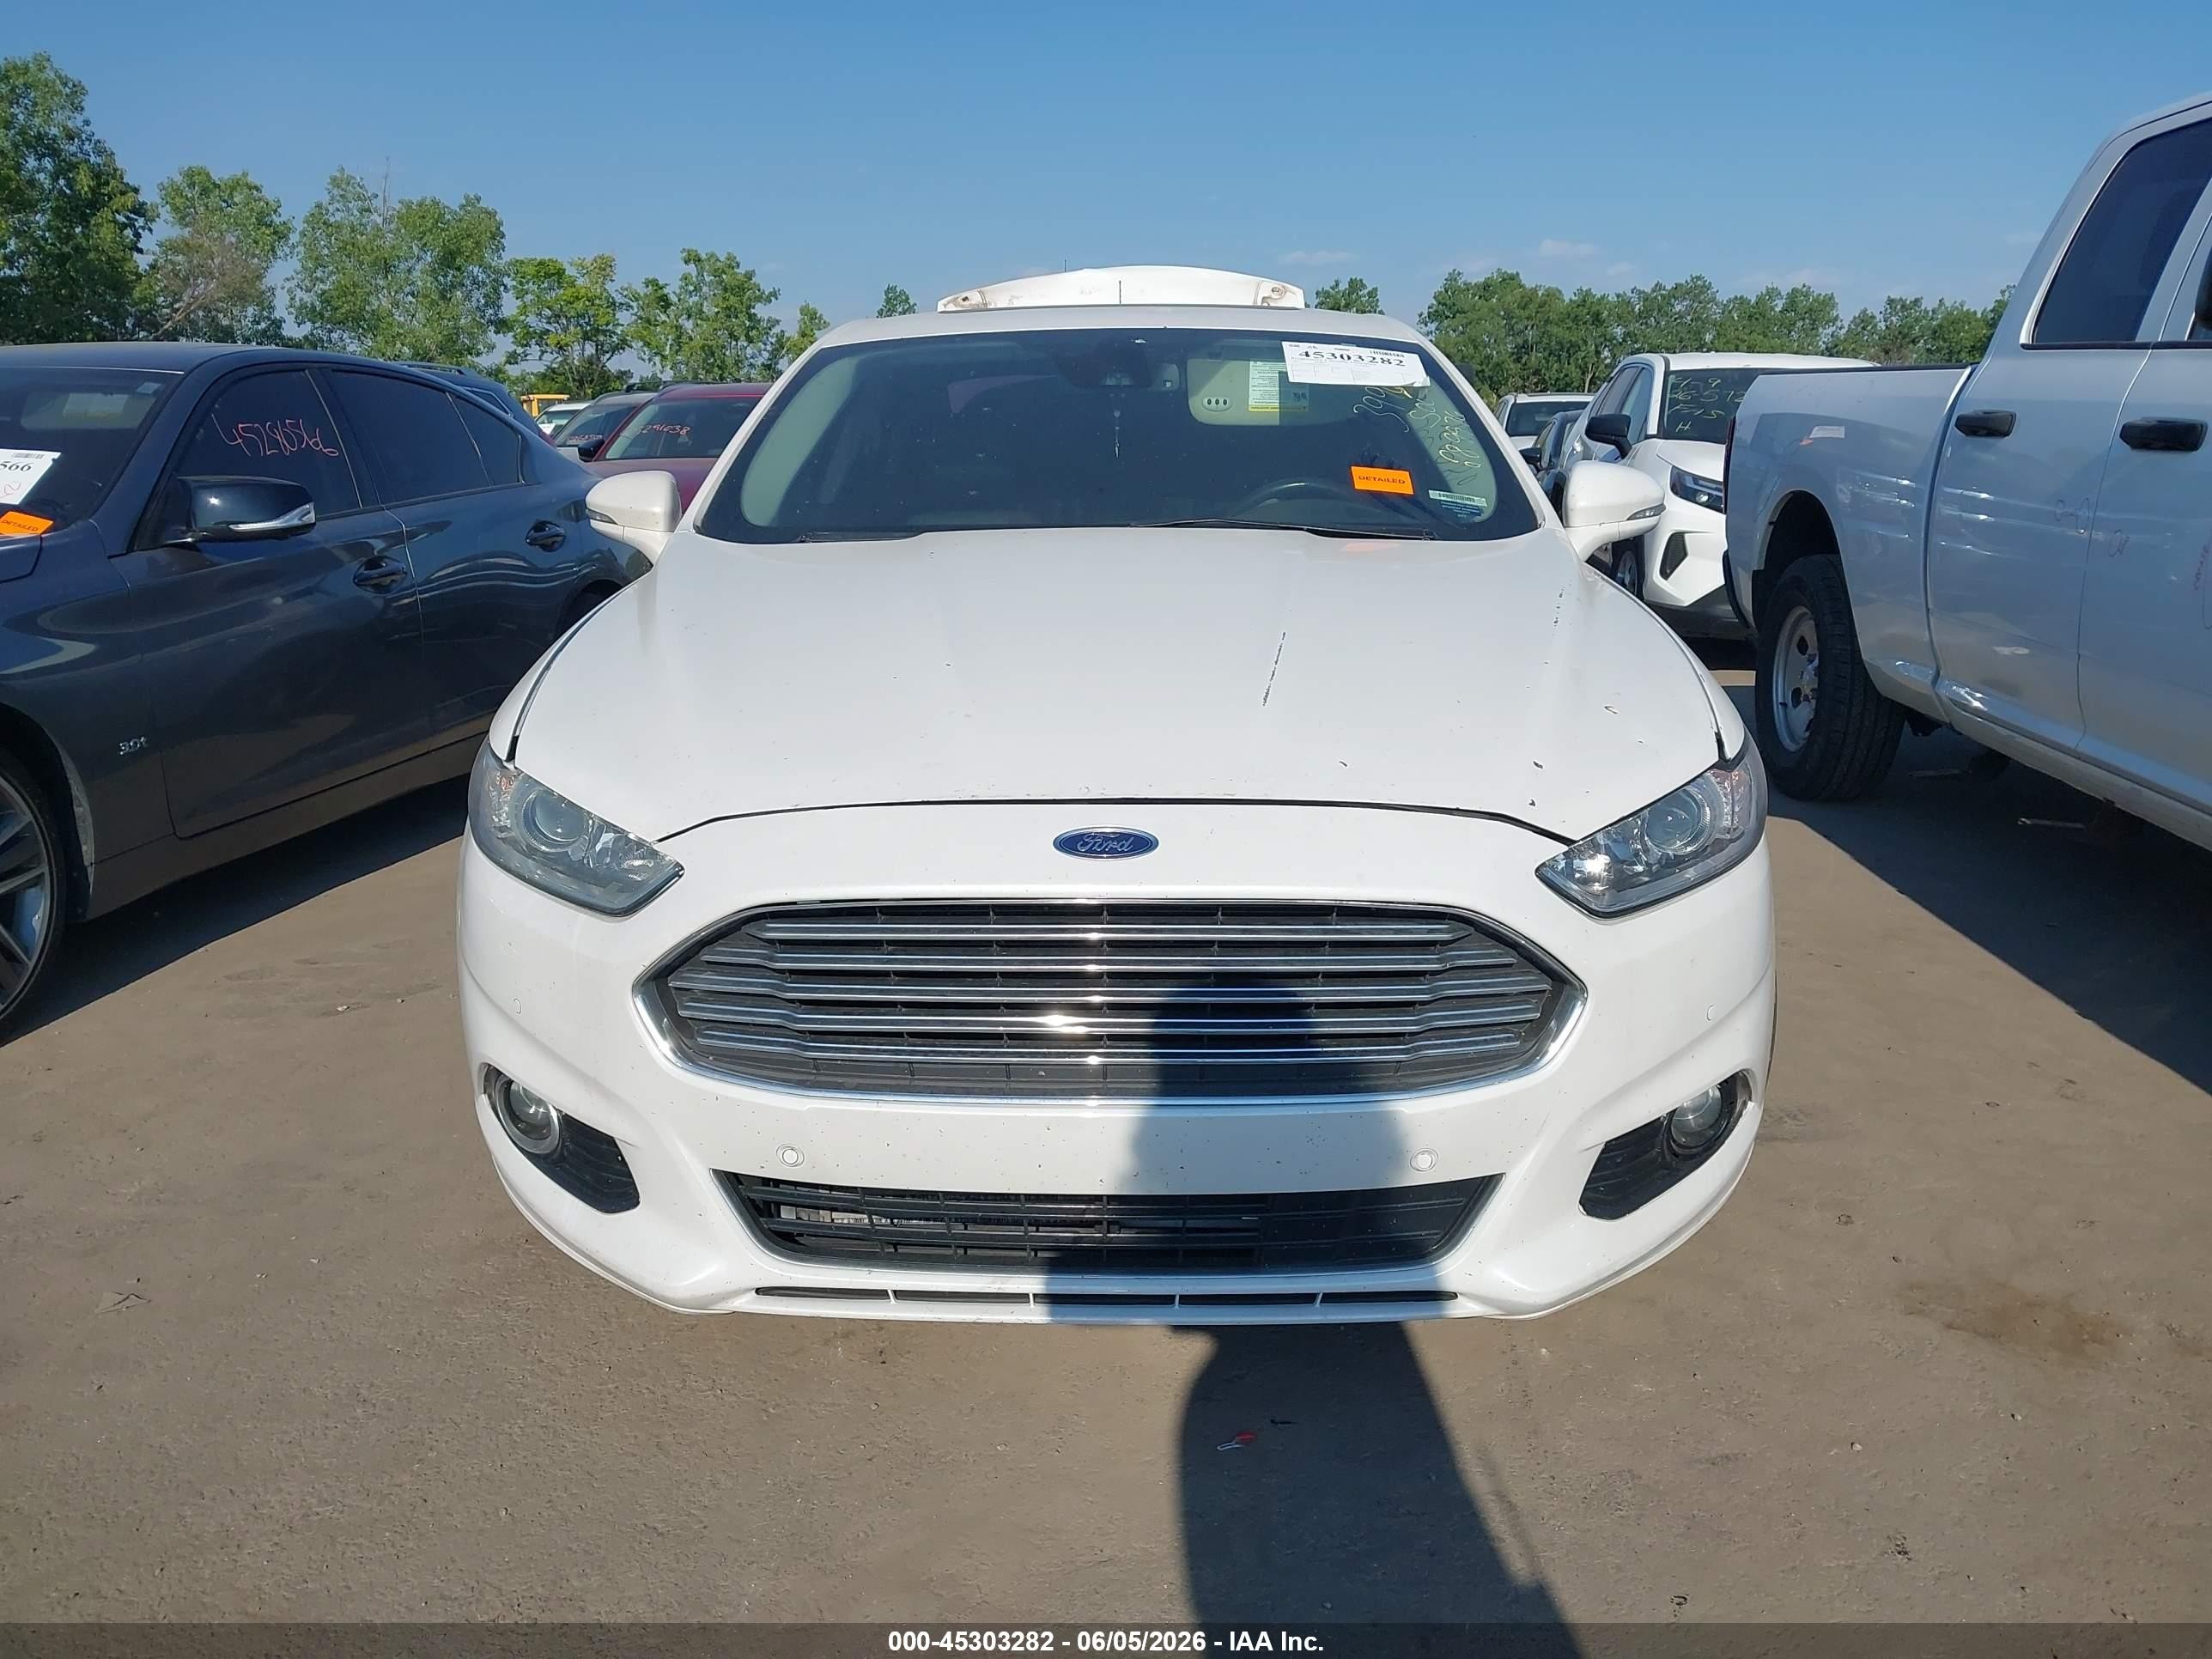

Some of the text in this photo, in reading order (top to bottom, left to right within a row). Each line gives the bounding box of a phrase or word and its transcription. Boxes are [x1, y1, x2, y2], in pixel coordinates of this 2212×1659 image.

[1298, 350, 1406, 367] 45303282
[1358, 475, 1406, 484] DETAILED
[2, 520, 39, 532] DETAILED
[1077, 832, 1134, 852] Ford
